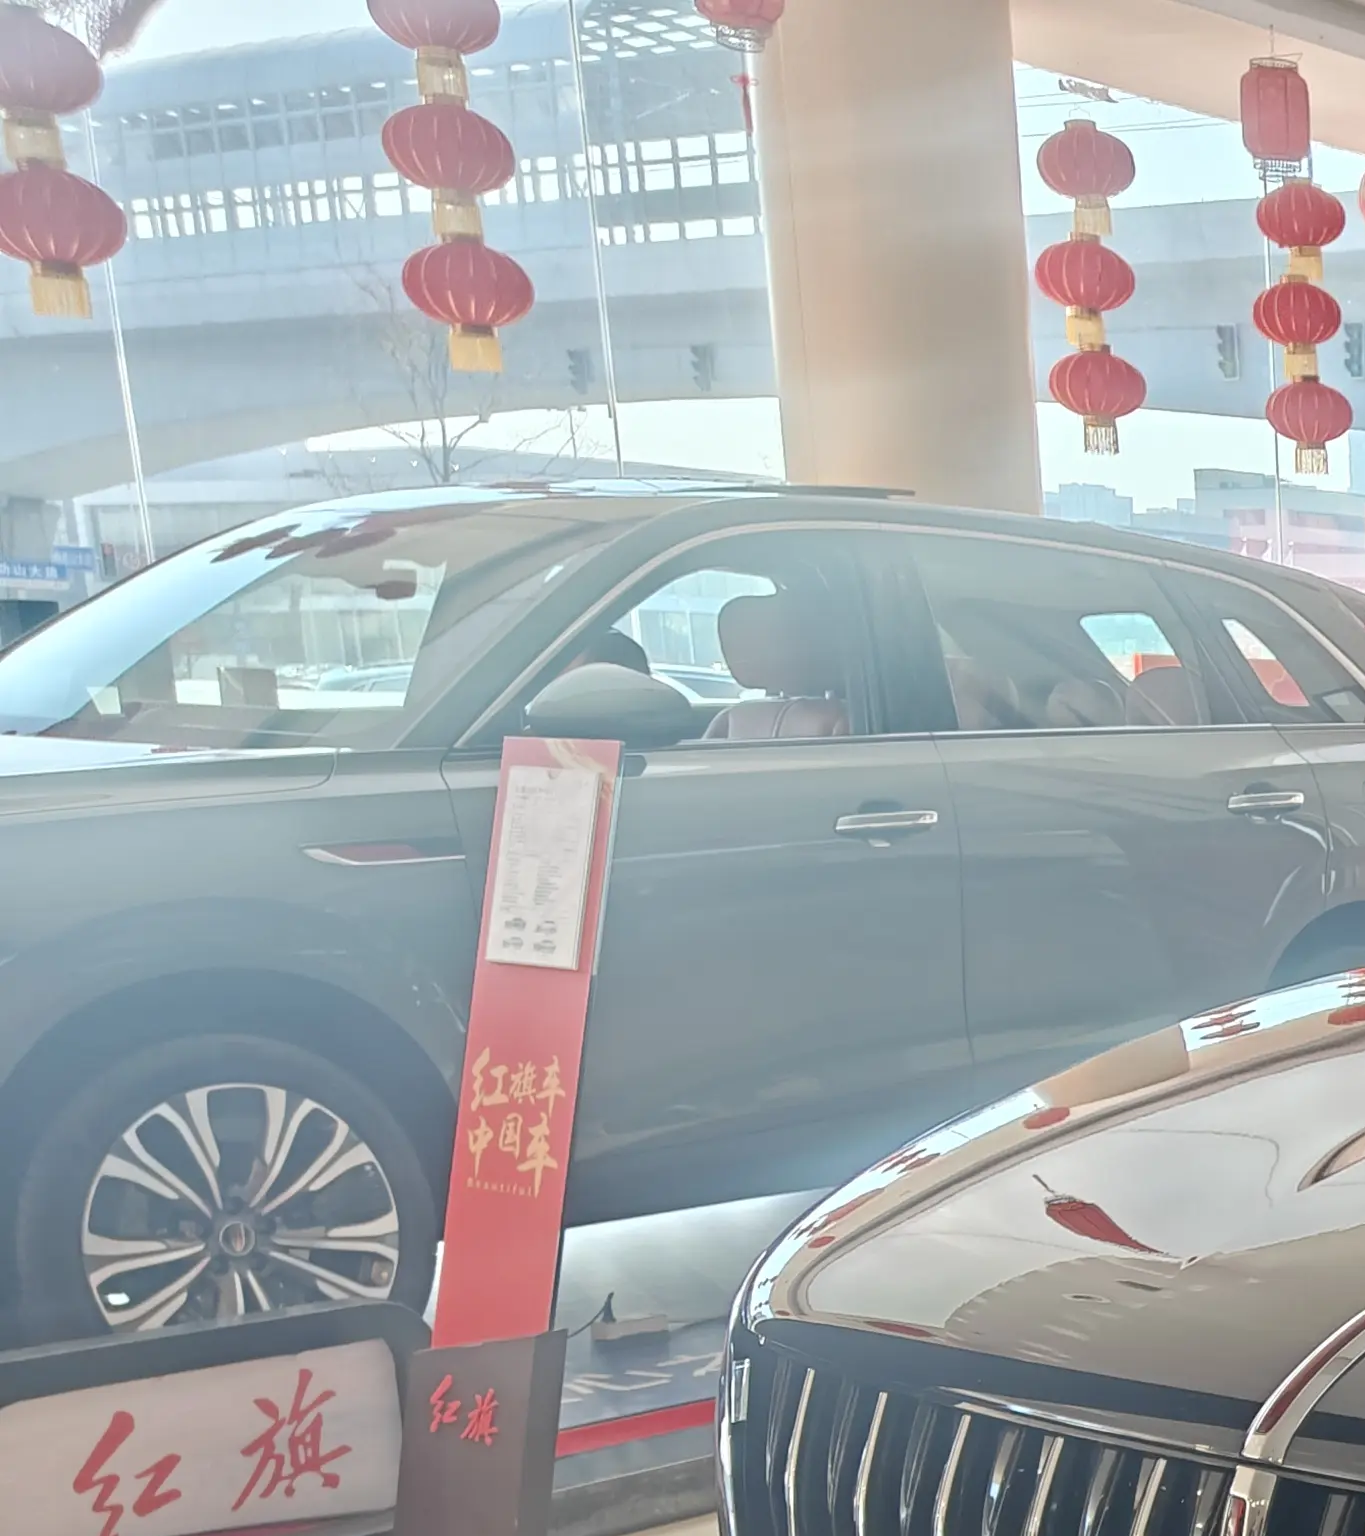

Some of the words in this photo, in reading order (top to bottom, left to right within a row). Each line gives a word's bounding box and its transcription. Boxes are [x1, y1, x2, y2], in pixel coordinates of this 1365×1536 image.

[470, 1047, 566, 1118] 红旗车
[466, 1112, 559, 1199] 中国车
[466, 1176, 534, 1197] Beautiful
[429, 1373, 500, 1447] 红旗
